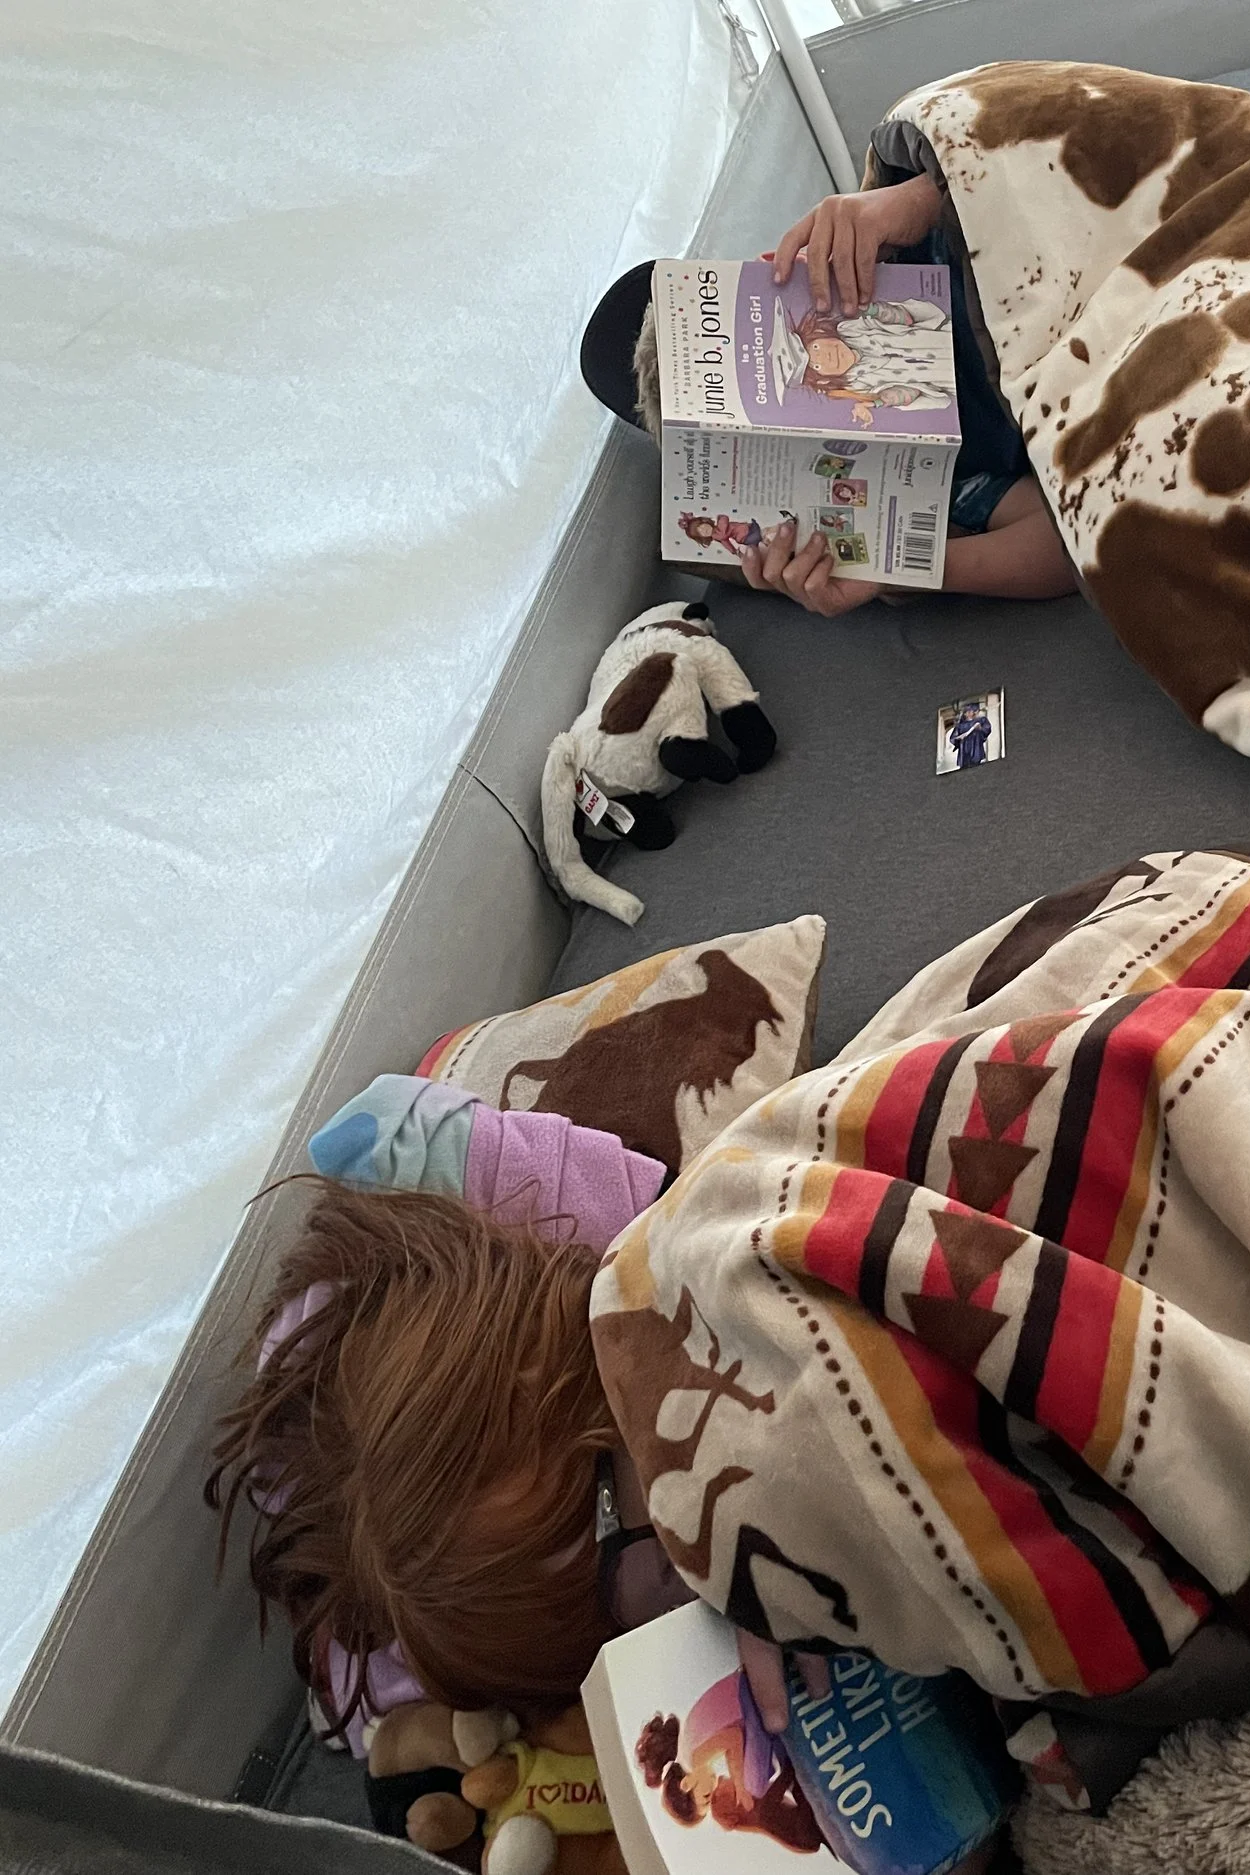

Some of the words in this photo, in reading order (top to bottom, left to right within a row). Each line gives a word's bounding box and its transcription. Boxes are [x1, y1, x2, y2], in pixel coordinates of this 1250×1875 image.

[695, 270, 730, 344] jones
[749, 295, 762, 323] Girl
[670, 312, 678, 357] Bestselling
[683, 346, 691, 387] BARBARA
[741, 353, 749, 363] Is
[752, 327, 768, 404] Graduation
[698, 372, 735, 419] junie
[683, 476, 697, 500] Laugh
[699, 486, 709, 500] the
[834, 1653, 892, 1752] LIKE
[526, 1785, 537, 1810] I
[561, 1780, 607, 1805] IDA
